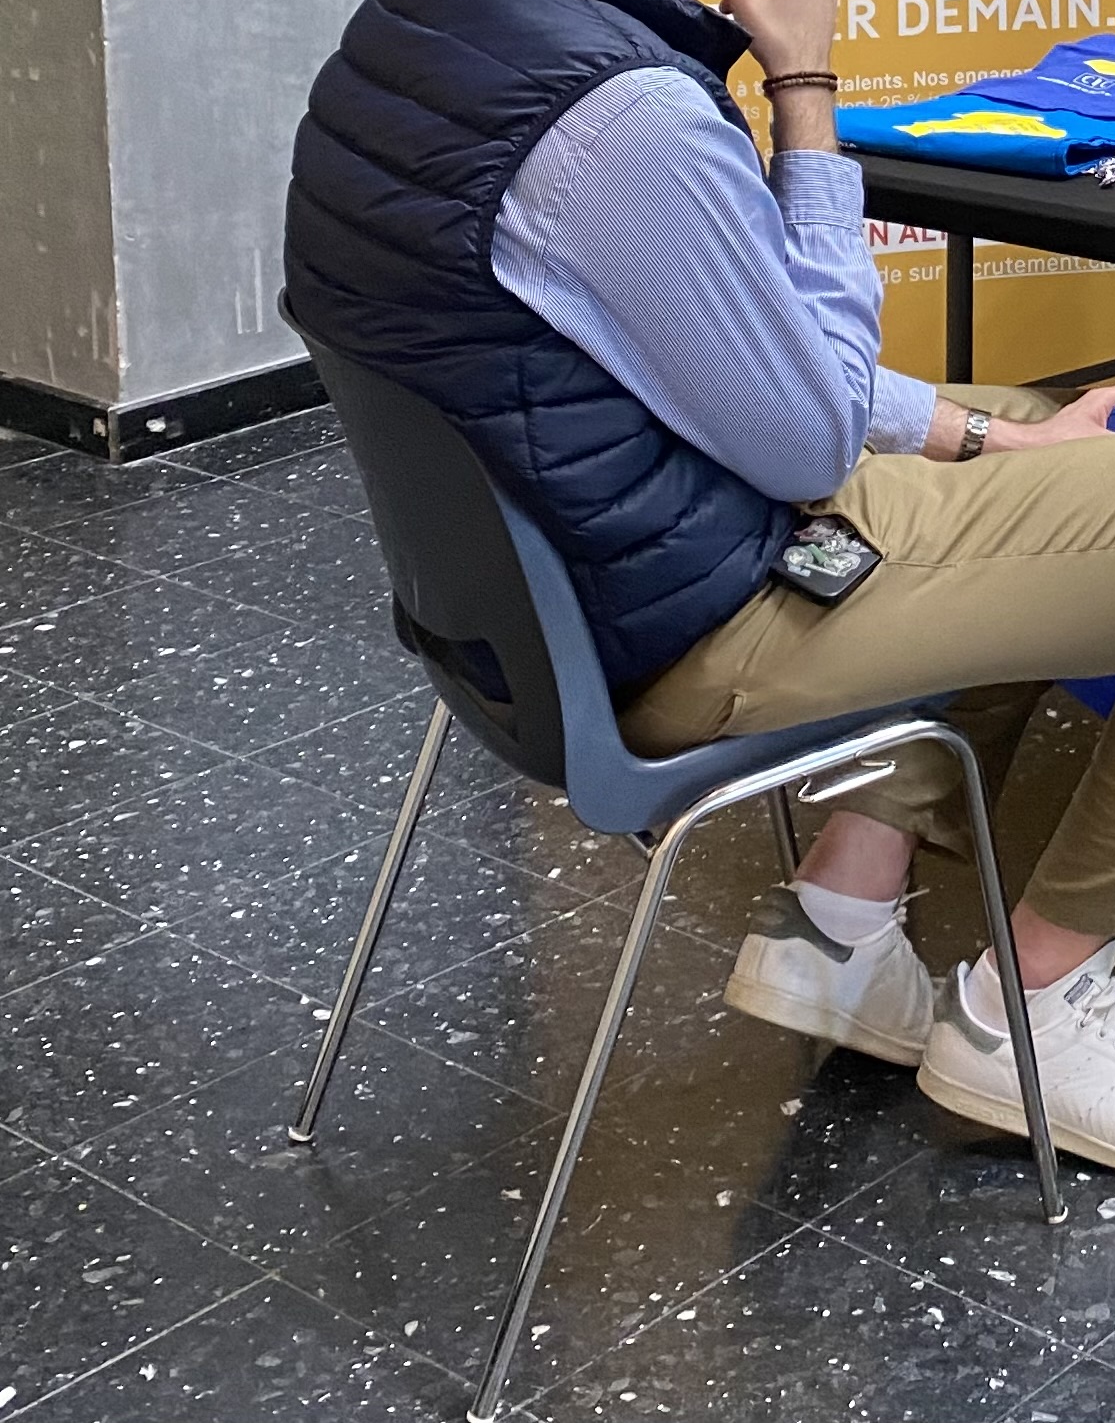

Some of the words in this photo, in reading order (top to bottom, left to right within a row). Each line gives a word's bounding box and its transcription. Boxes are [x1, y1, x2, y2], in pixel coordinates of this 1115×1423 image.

[837, 74, 908, 93] talents.
[914, 71, 949, 88] Nos
[909, 264, 943, 282] sur
